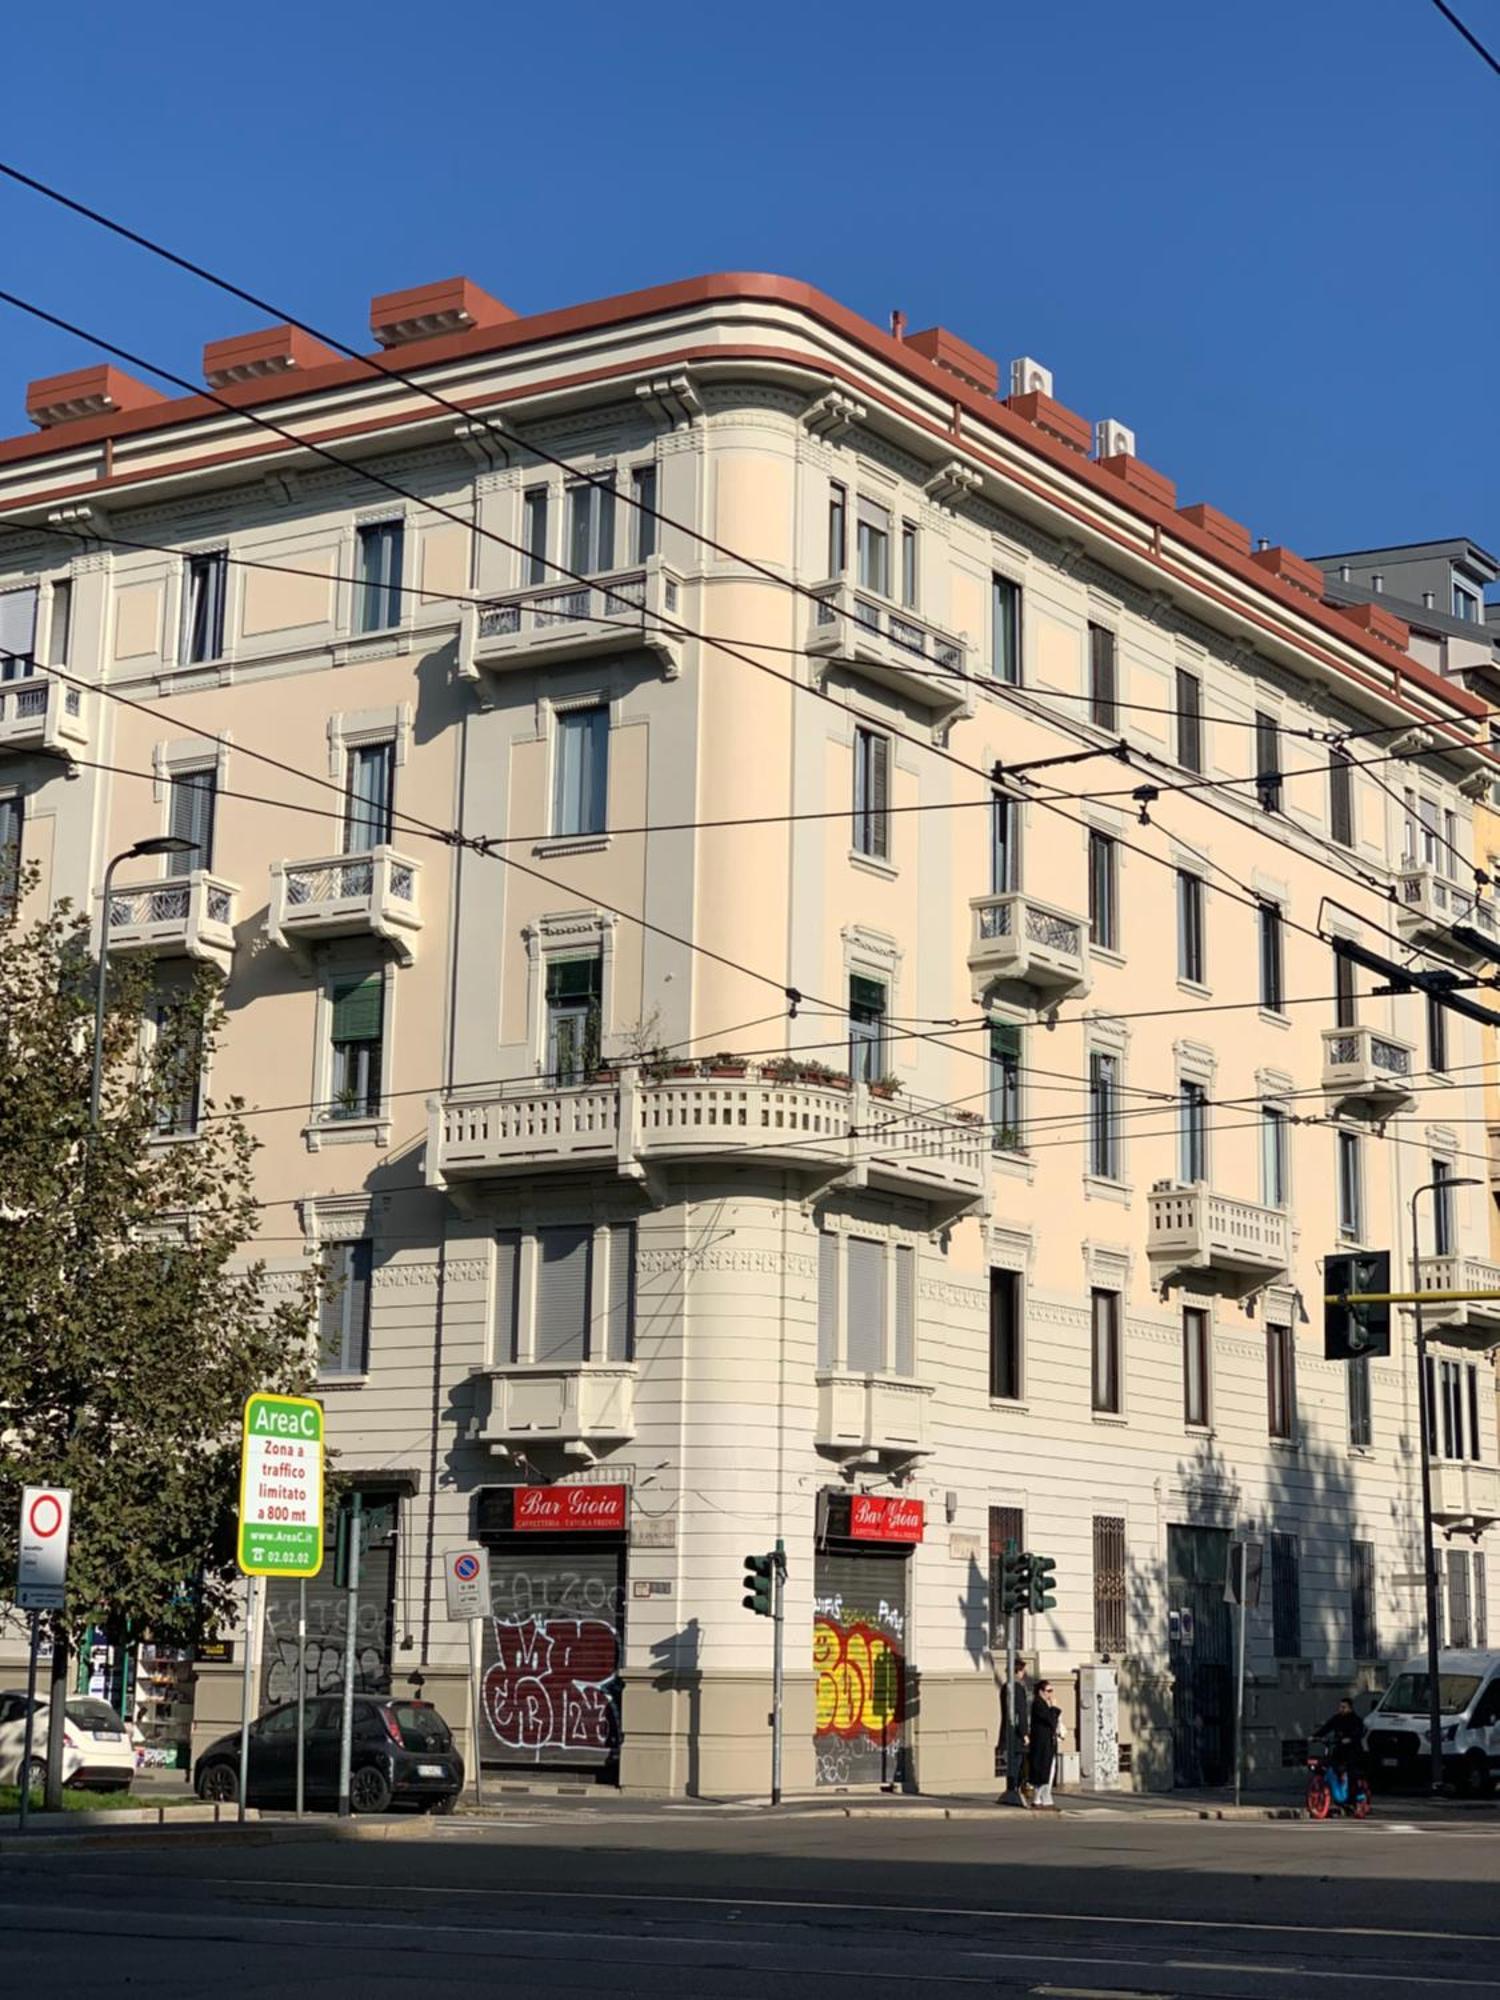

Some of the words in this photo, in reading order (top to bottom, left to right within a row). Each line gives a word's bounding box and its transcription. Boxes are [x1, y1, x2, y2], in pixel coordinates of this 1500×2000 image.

[264, 1440, 294, 1456] Zona
[297, 1446, 305, 1457] a
[262, 1462, 306, 1479] traffico
[259, 1483, 306, 1500] limitato
[520, 1490, 561, 1515] Bar
[567, 1489, 618, 1515] Gioia
[257, 1508, 265, 1519] a
[267, 1506, 289, 1521] 800
[291, 1510, 306, 1522] mt
[855, 1499, 883, 1524] Bar
[887, 1501, 919, 1529] Gioia
[250, 1531, 313, 1543] www.AreaC.it
[267, 1551, 310, 1564] 02.02.02
